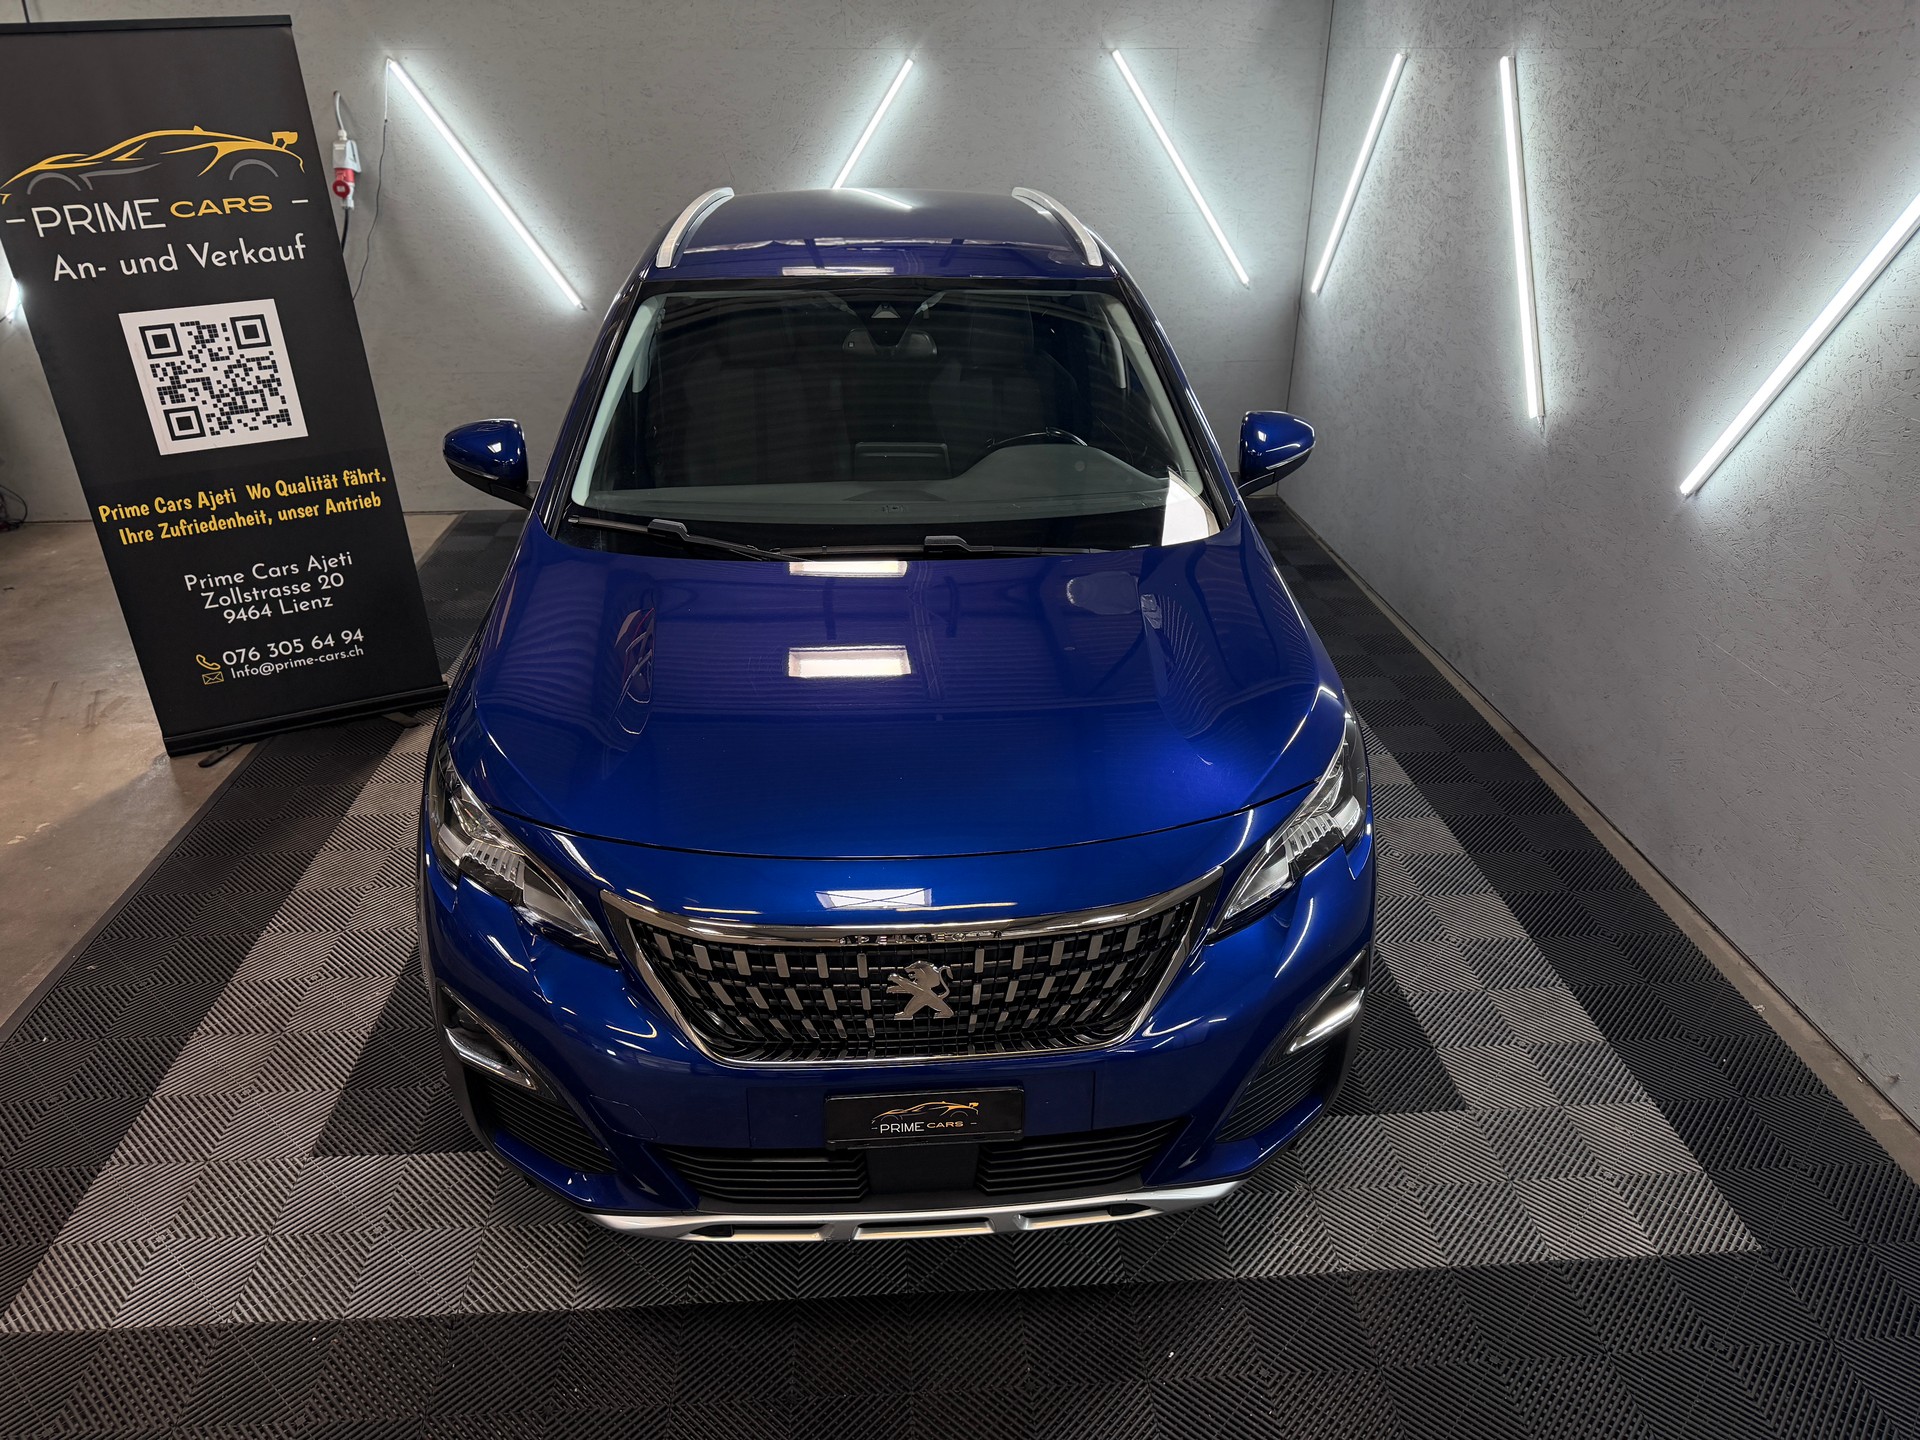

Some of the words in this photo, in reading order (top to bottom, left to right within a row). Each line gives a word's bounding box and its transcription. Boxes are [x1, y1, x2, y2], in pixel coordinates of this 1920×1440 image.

[32, 199, 166, 237] PRIME
[170, 195, 273, 219] CARS
[54, 254, 106, 281] An-
[120, 244, 179, 275] und
[187, 233, 306, 268] Verkauf
[98, 501, 150, 523] Prime
[154, 496, 192, 514] Cars
[198, 488, 237, 512] Ajeti
[246, 484, 271, 501] Wo
[275, 472, 339, 499] Qualität
[343, 467, 387, 486] fährt.
[119, 527, 154, 545] Ihre
[158, 509, 273, 540] Zufriedenheit,
[278, 504, 320, 522] unser
[325, 492, 382, 515] Antrieb
[183, 569, 245, 592] Prime
[252, 561, 300, 580] Cars
[307, 551, 353, 575] Ajeti
[201, 581, 311, 610] Zollstrasse
[318, 572, 345, 591] 20
[223, 604, 272, 624] 9464
[280, 595, 333, 615] Lienz
[222, 647, 261, 666] 076
[268, 639, 304, 658] 305
[311, 633, 335, 651] 64
[341, 628, 364, 645] 94
[231, 646, 364, 679] Info@prime-cars.ch
[880, 1121, 925, 1134] PRIME
[926, 1120, 964, 1129] CARS
